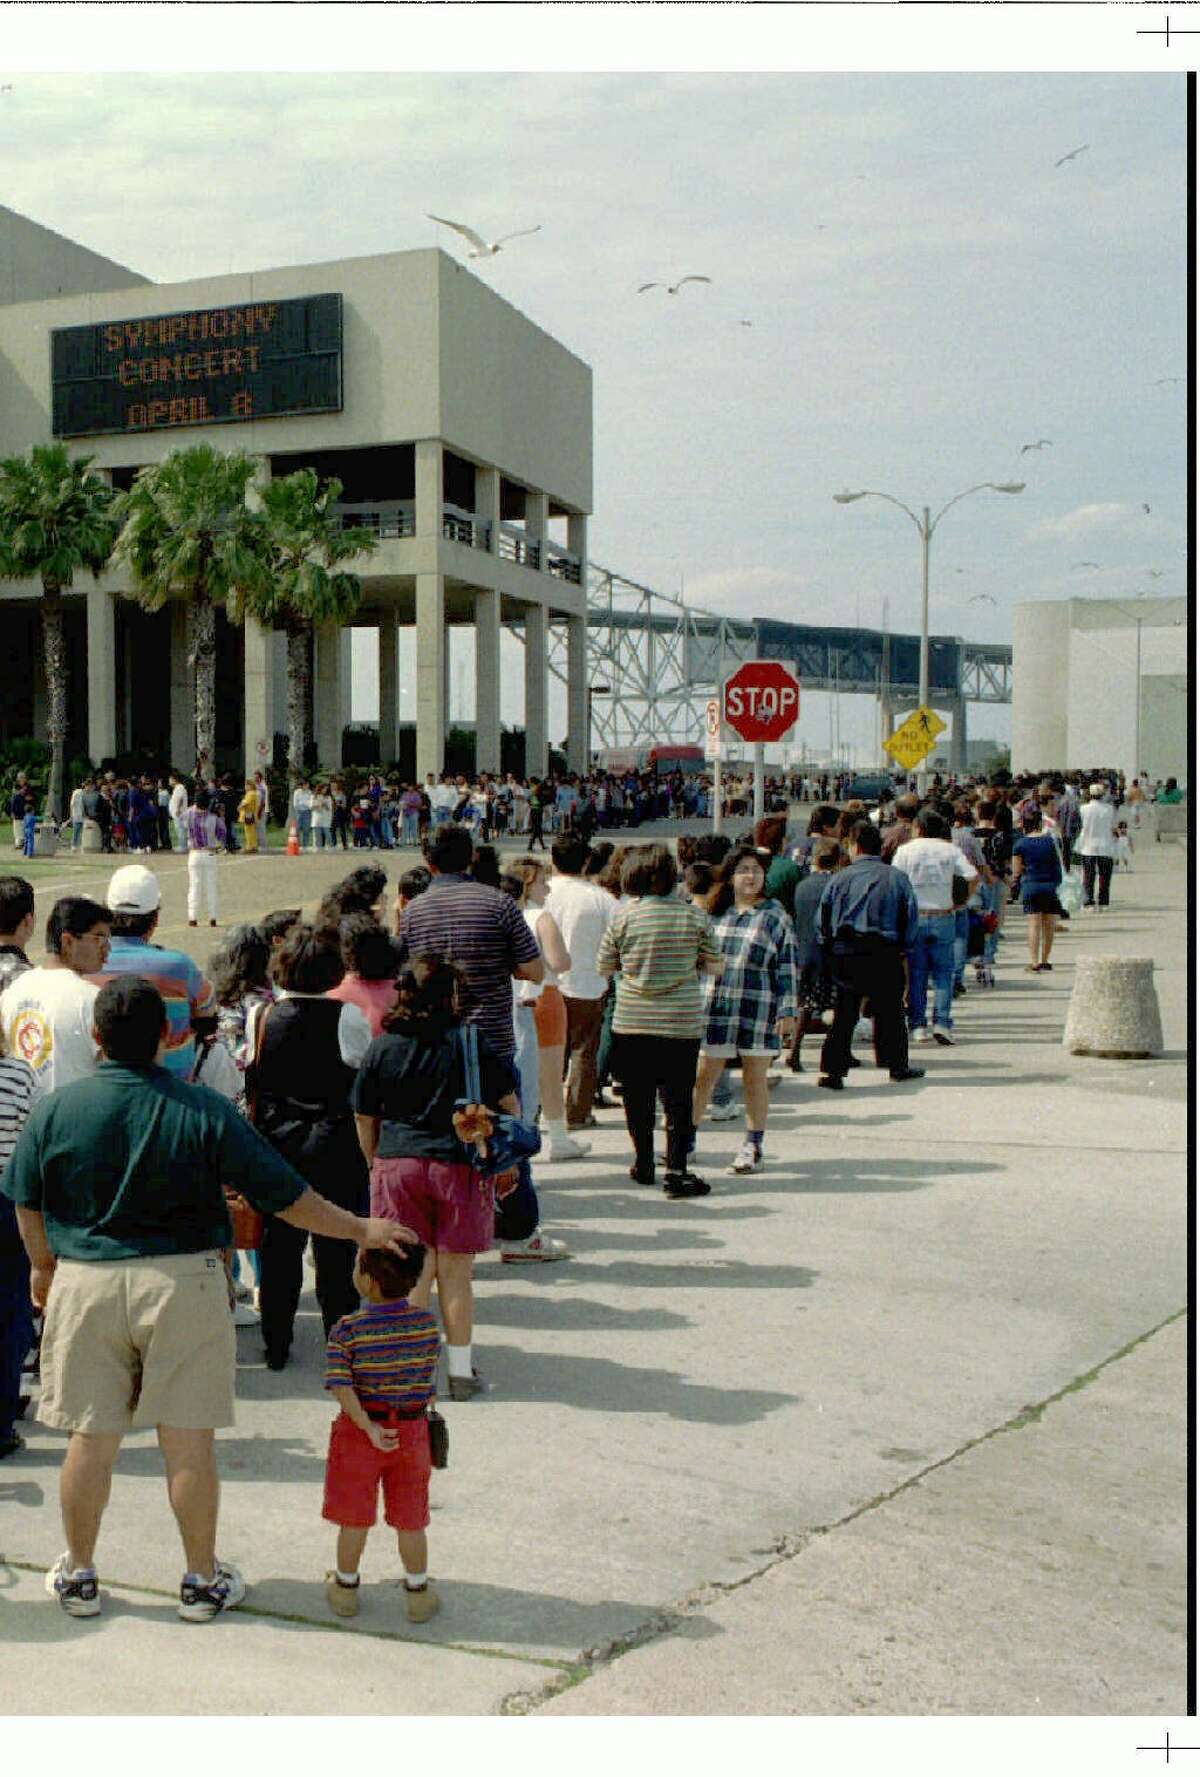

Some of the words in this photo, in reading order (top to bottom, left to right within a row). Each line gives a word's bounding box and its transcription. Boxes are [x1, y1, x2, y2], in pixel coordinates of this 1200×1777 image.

[104, 303, 280, 352] SYMPHONY
[118, 346, 262, 385] CONCERT
[128, 395, 213, 424] APRIL
[728, 686, 795, 717] STOP
[888, 742, 930, 753] OUTLET
[901, 730, 918, 740] NO
